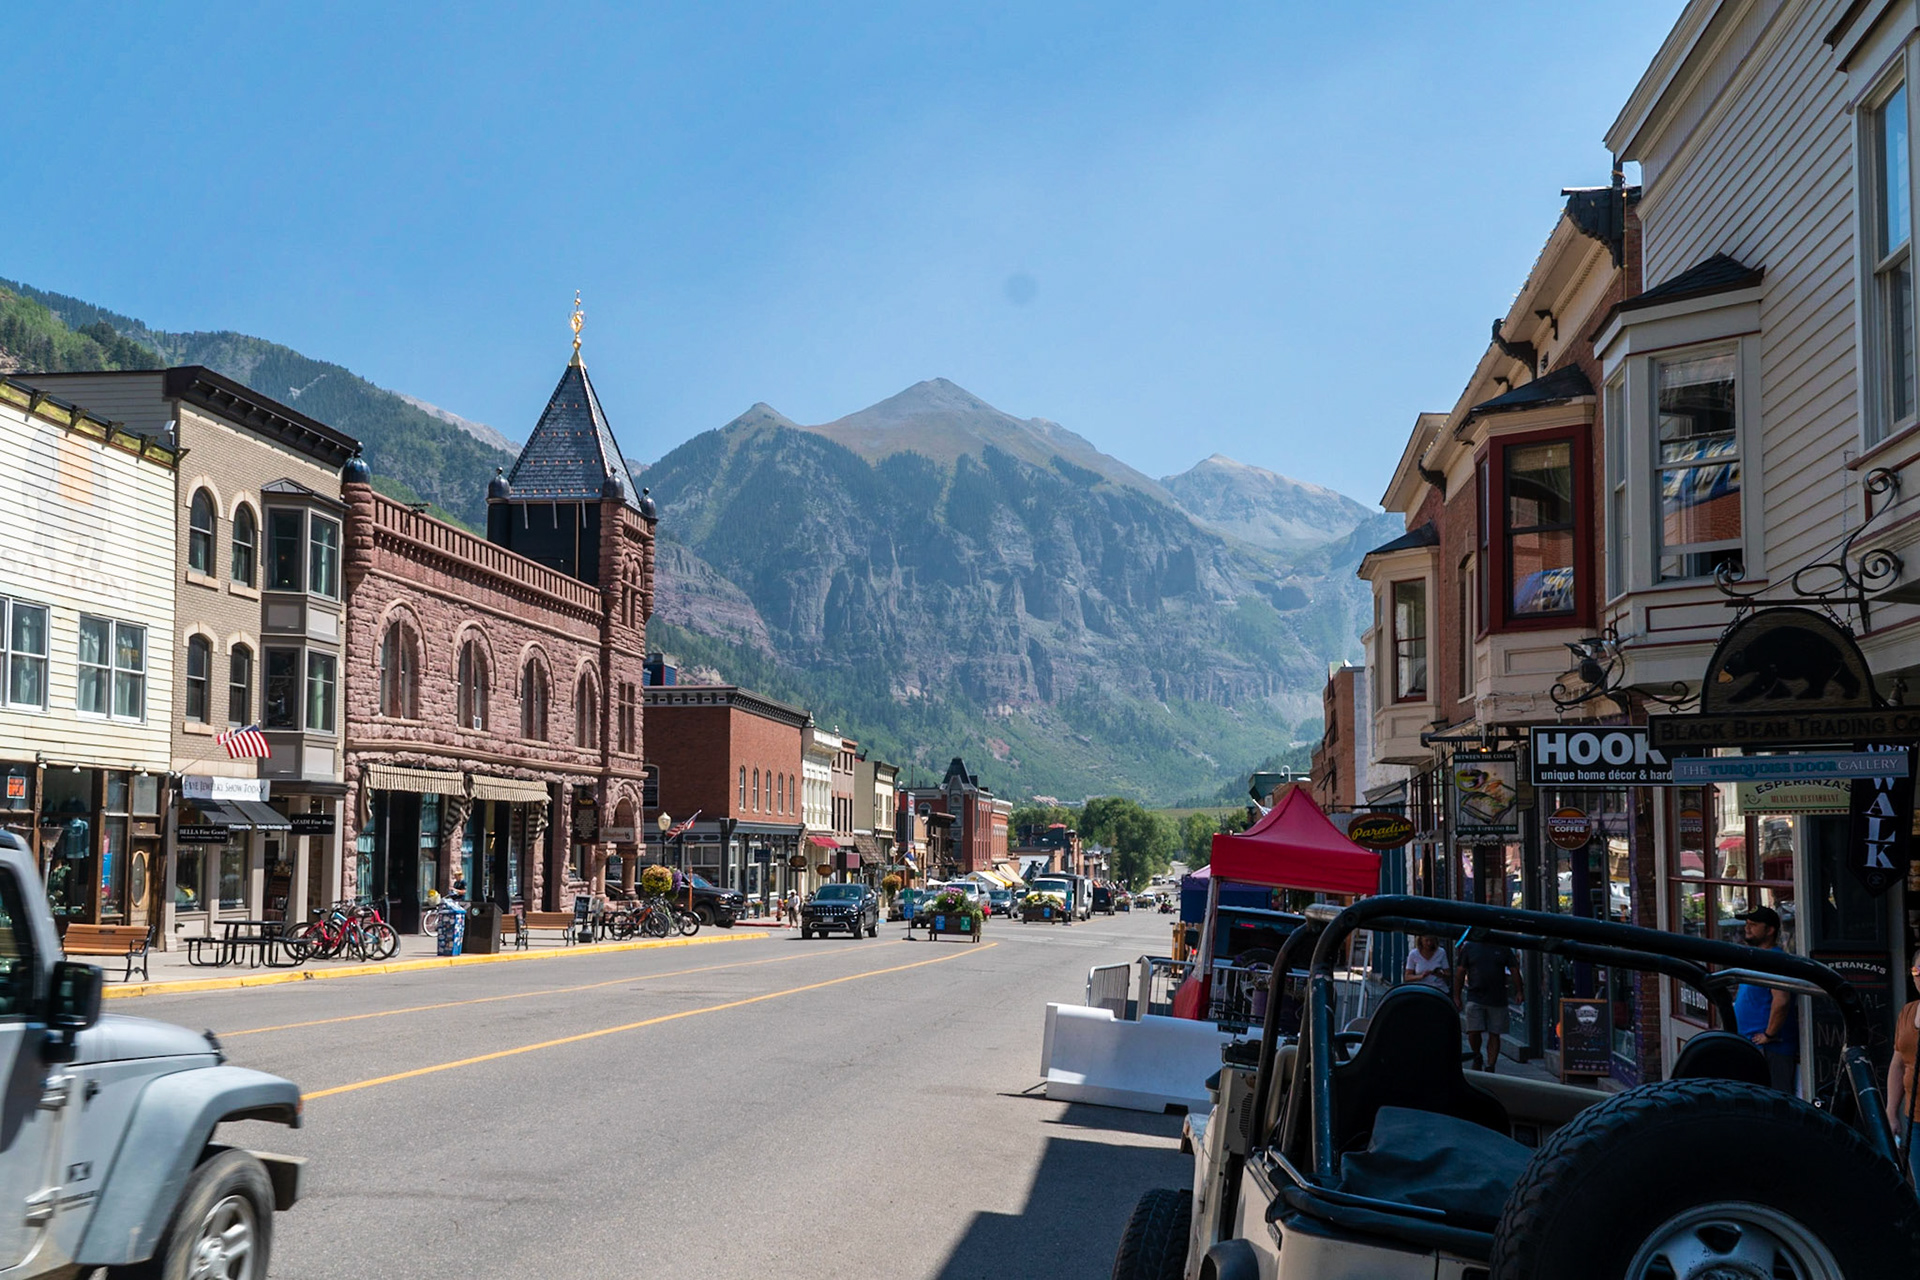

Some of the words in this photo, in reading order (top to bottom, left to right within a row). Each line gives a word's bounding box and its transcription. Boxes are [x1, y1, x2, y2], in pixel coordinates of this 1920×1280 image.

[1661, 722, 1723, 742] BLACK
[1734, 719, 1791, 739] BEAR
[1794, 716, 1886, 736] TRADING
[1537, 732, 1668, 765] HOOK
[1540, 769, 1576, 782] unique
[1577, 769, 1606, 780] home
[1608, 769, 1637, 780] décor
[1638, 770, 1647, 780] &
[1682, 765, 1707, 776] THE
[1709, 762, 1791, 777] TURQUOISE
[1793, 761, 1838, 773] DOOR
[1838, 759, 1898, 771] GALLERY
[184, 781, 199, 791] FINE
[225, 783, 242, 792] SHOW
[244, 784, 266, 794] TODAY
[1755, 779, 1852, 794] ESPERANZA'S
[1770, 794, 1798, 804] MEXICAN
[1799, 794, 1839, 803] RESTAURANT
[1352, 821, 1412, 841] Paradise
[1827, 961, 1888, 975] PERANZA'S
